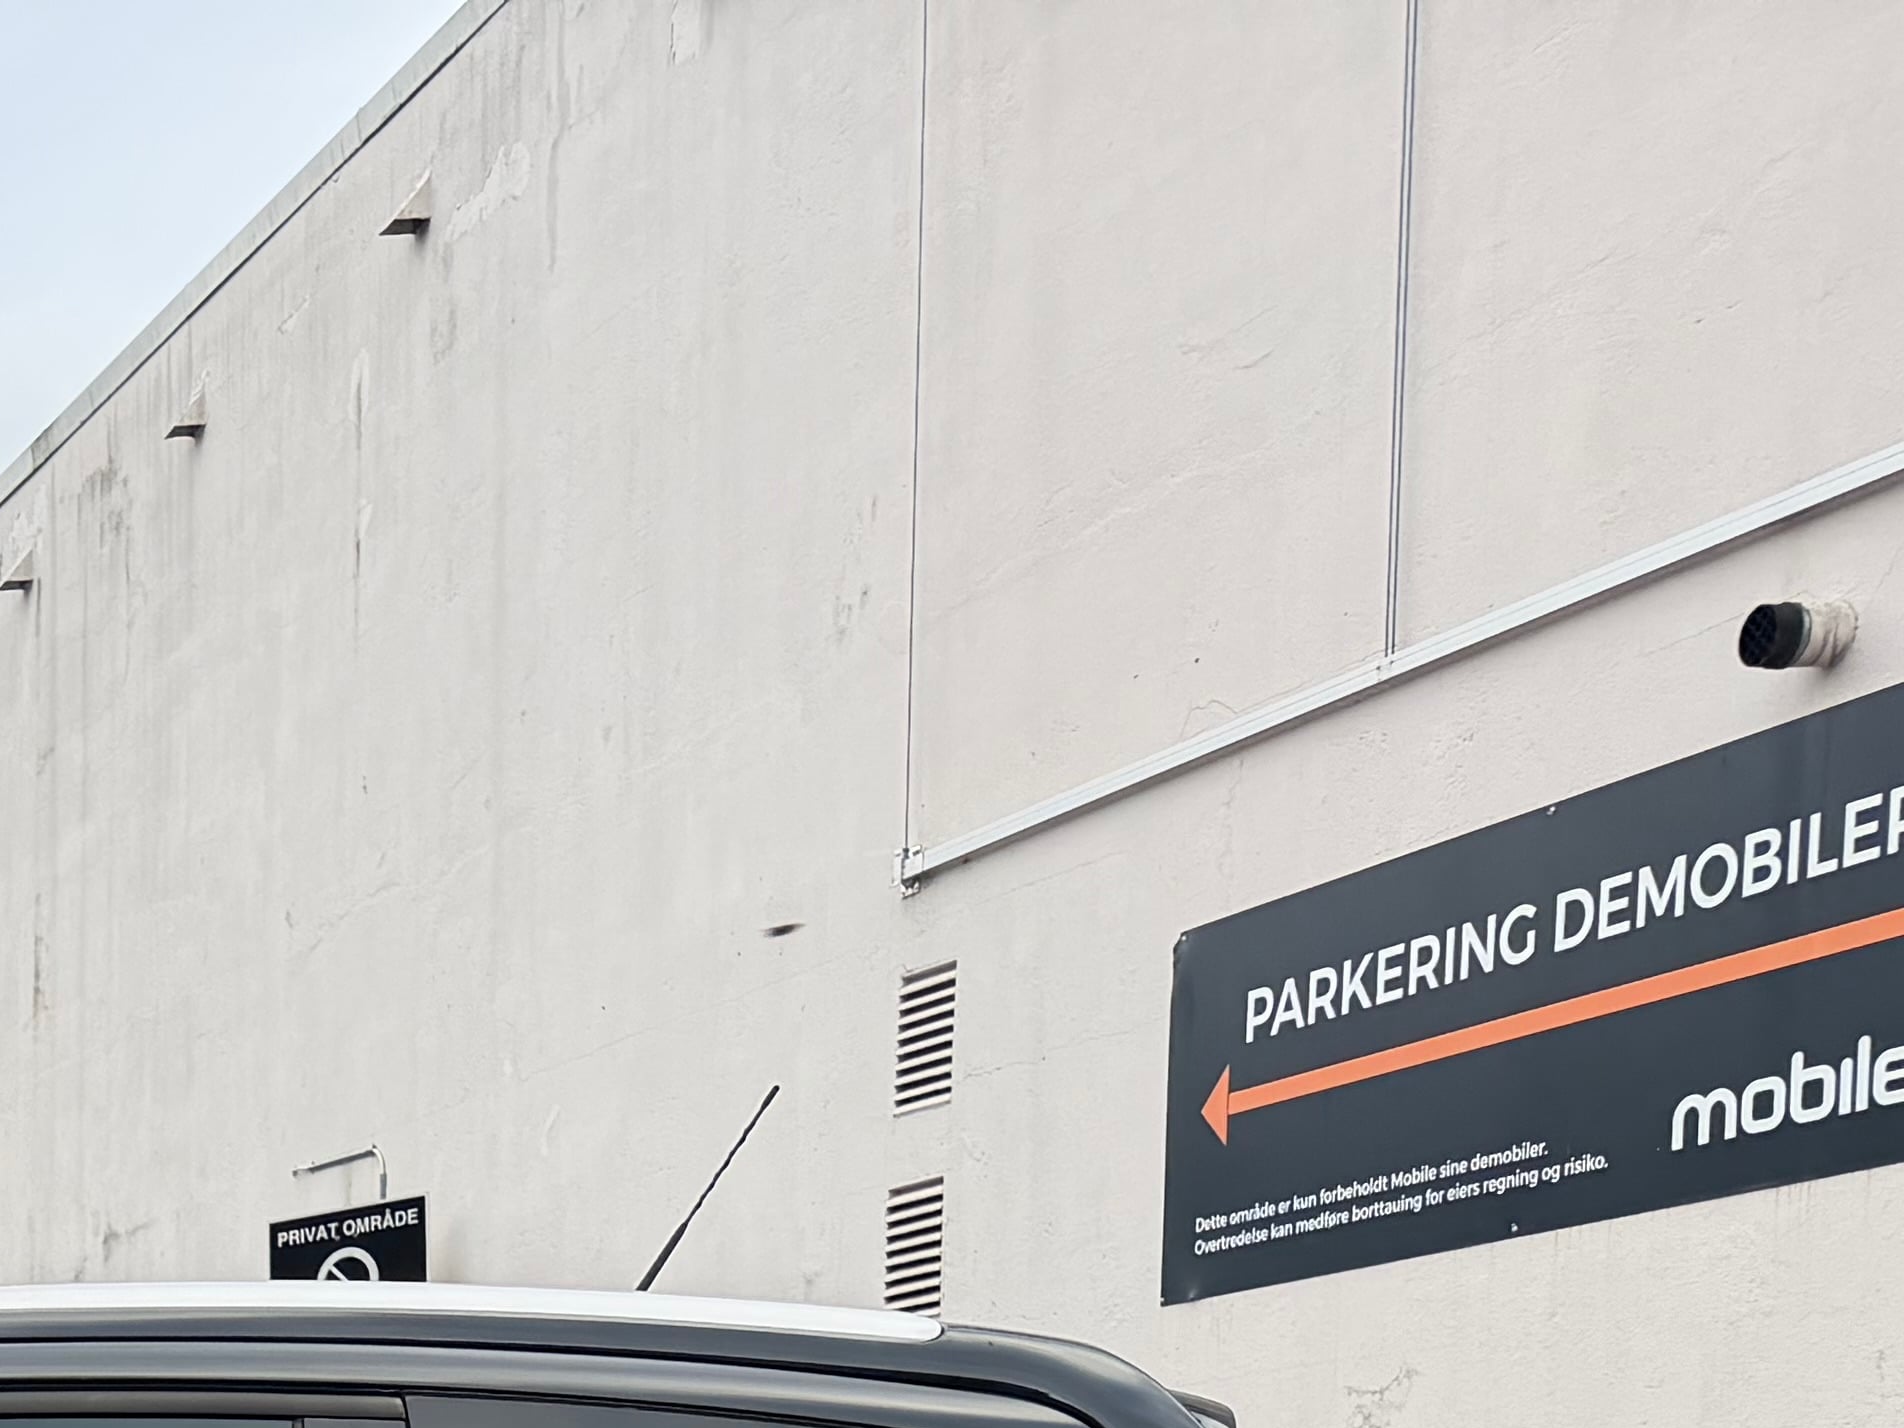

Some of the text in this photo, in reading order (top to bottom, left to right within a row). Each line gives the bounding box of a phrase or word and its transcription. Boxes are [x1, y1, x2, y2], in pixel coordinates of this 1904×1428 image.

[1245, 903, 1538, 1044] PARKERING
[1671, 1034, 1904, 1152] mobile
[277, 1208, 419, 1248] PRIVAT OMRÅDE
[1194, 1152, 1610, 1256] Overtredelse kan medføre borttauing for eiers regning og risiko.
[1195, 1141, 1549, 1234] Dette område er kun forbeholdt Mobile sine demobiler.
